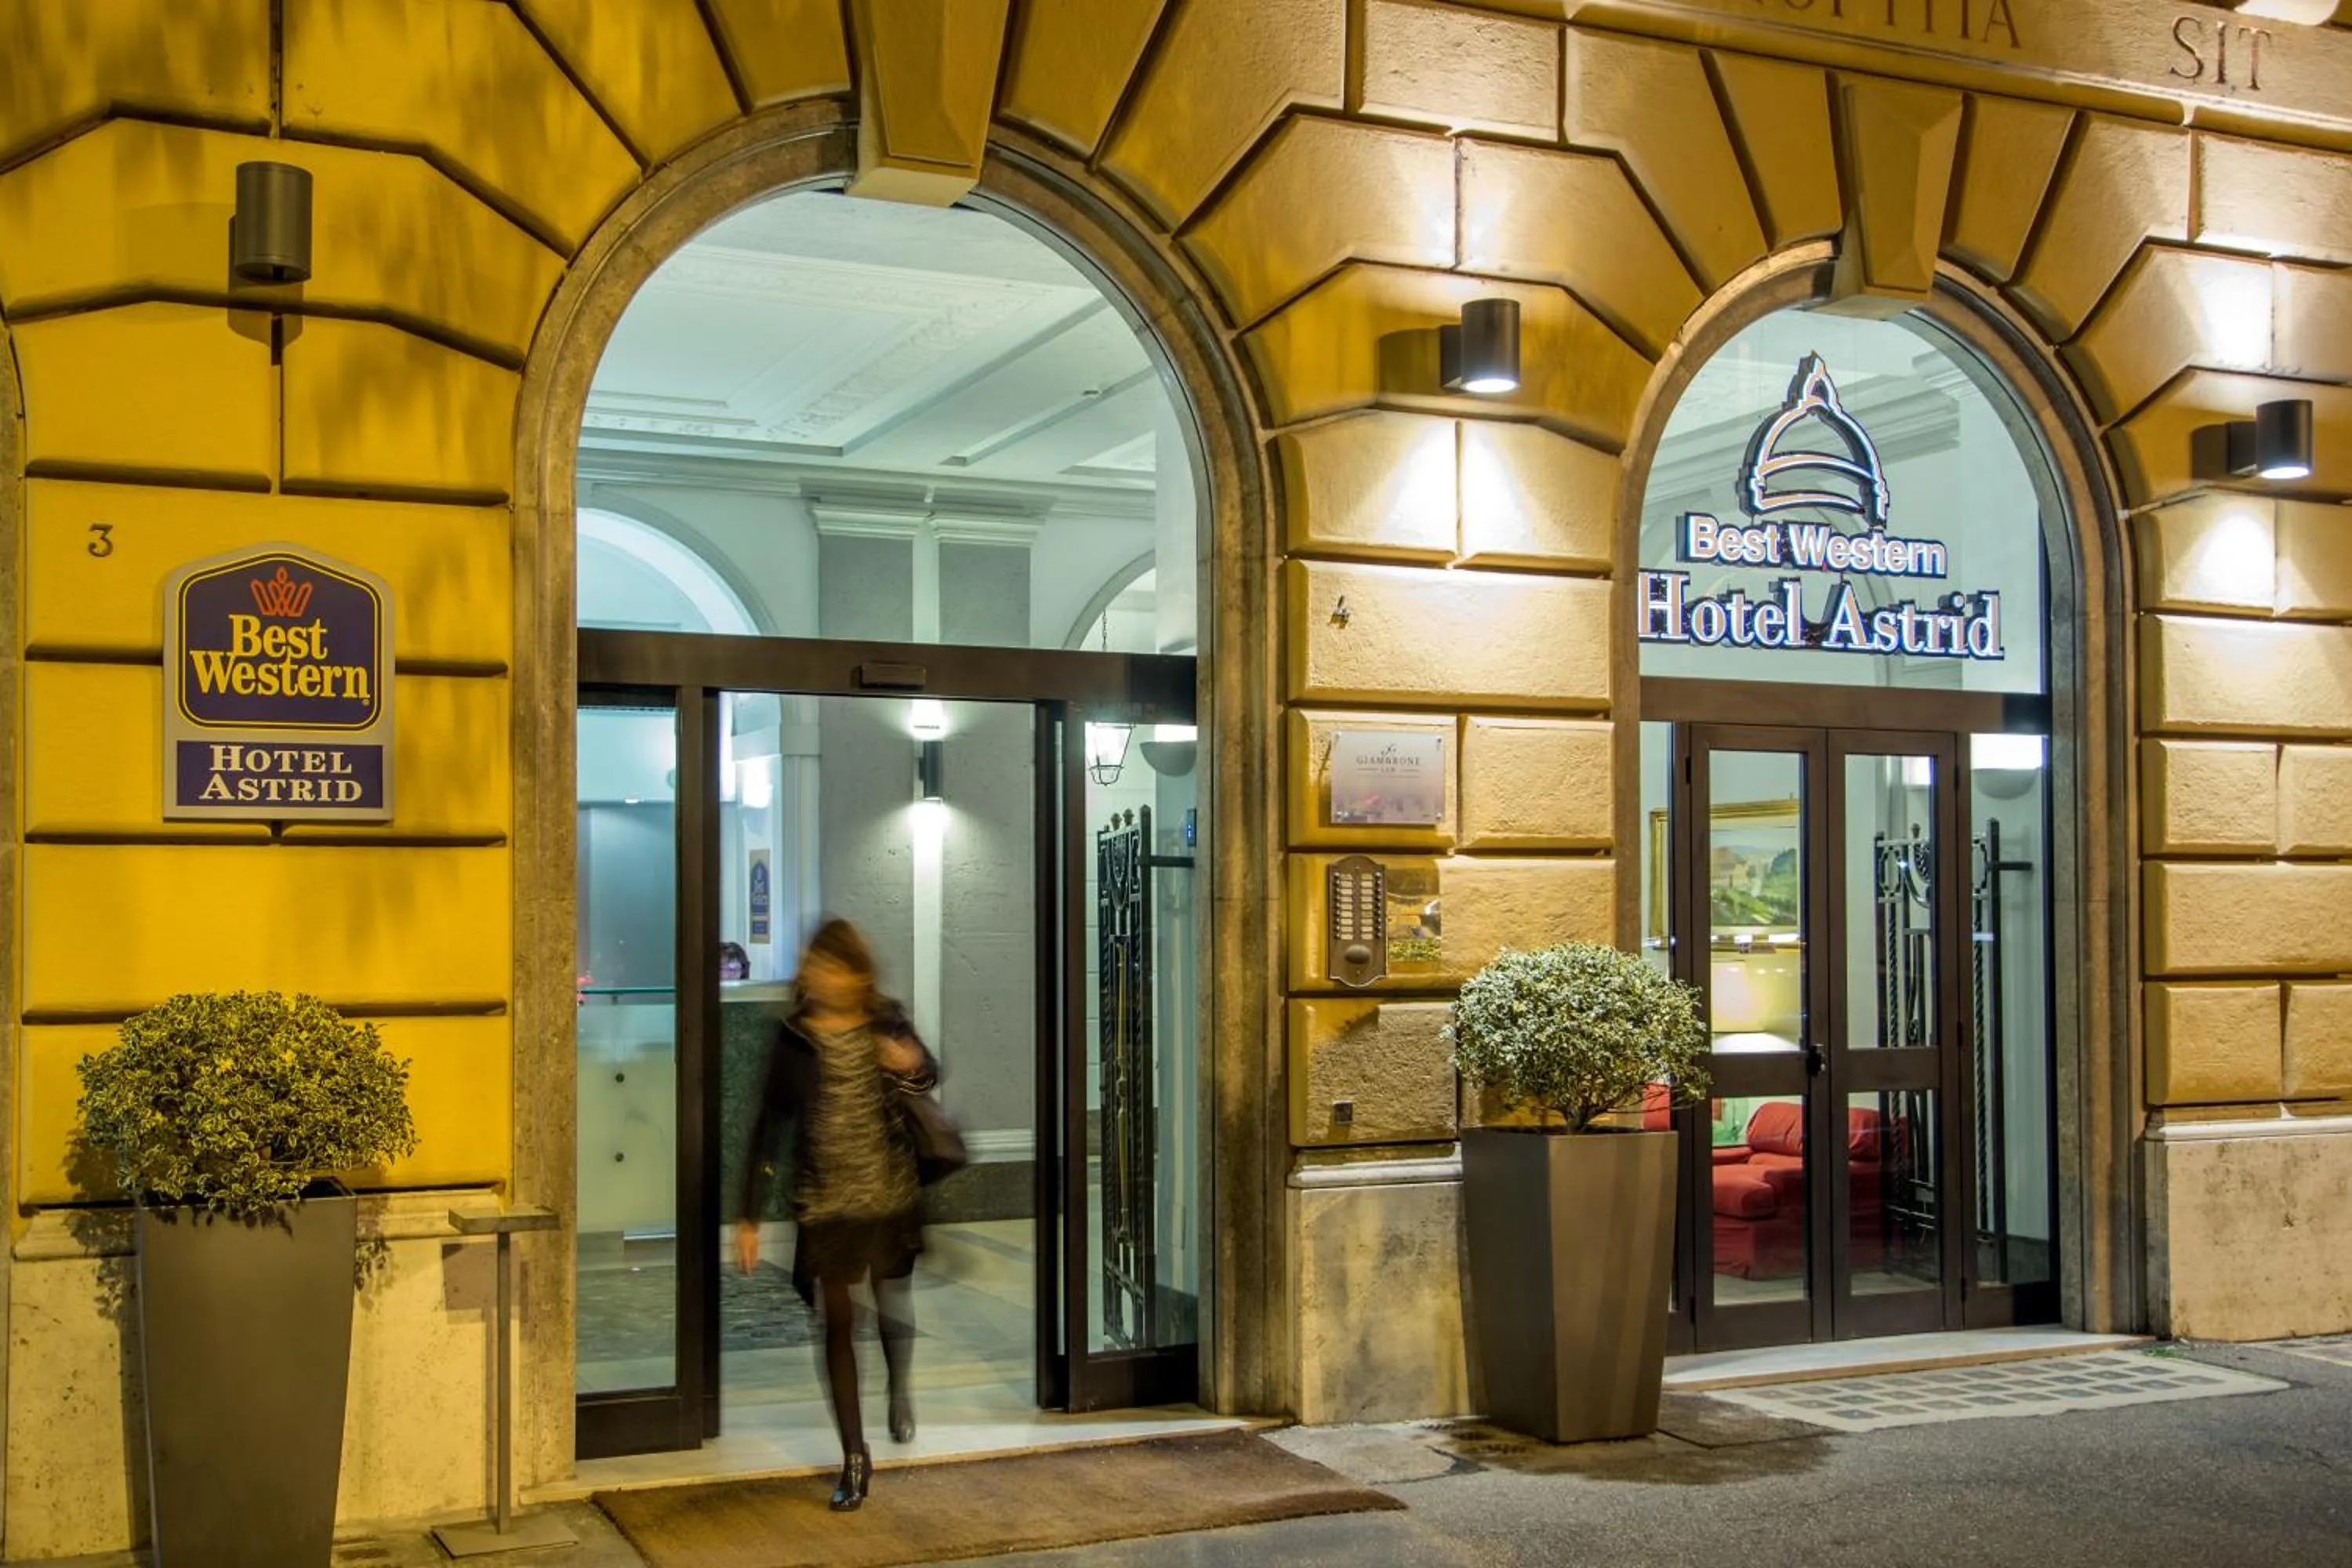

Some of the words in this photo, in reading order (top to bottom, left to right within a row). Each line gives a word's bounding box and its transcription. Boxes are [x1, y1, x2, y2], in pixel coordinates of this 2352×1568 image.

[2169, 16, 2271, 91] SIT
[87, 523, 114, 557] 3
[1686, 512, 1781, 564] Best
[1784, 522, 1947, 577] Western
[228, 614, 328, 660] Best
[1639, 570, 1806, 648] Hotel
[1821, 581, 2005, 659] Astrid
[189, 650, 370, 699] Western
[209, 745, 353, 774] HOTEL
[198, 774, 363, 804] ASTRID
